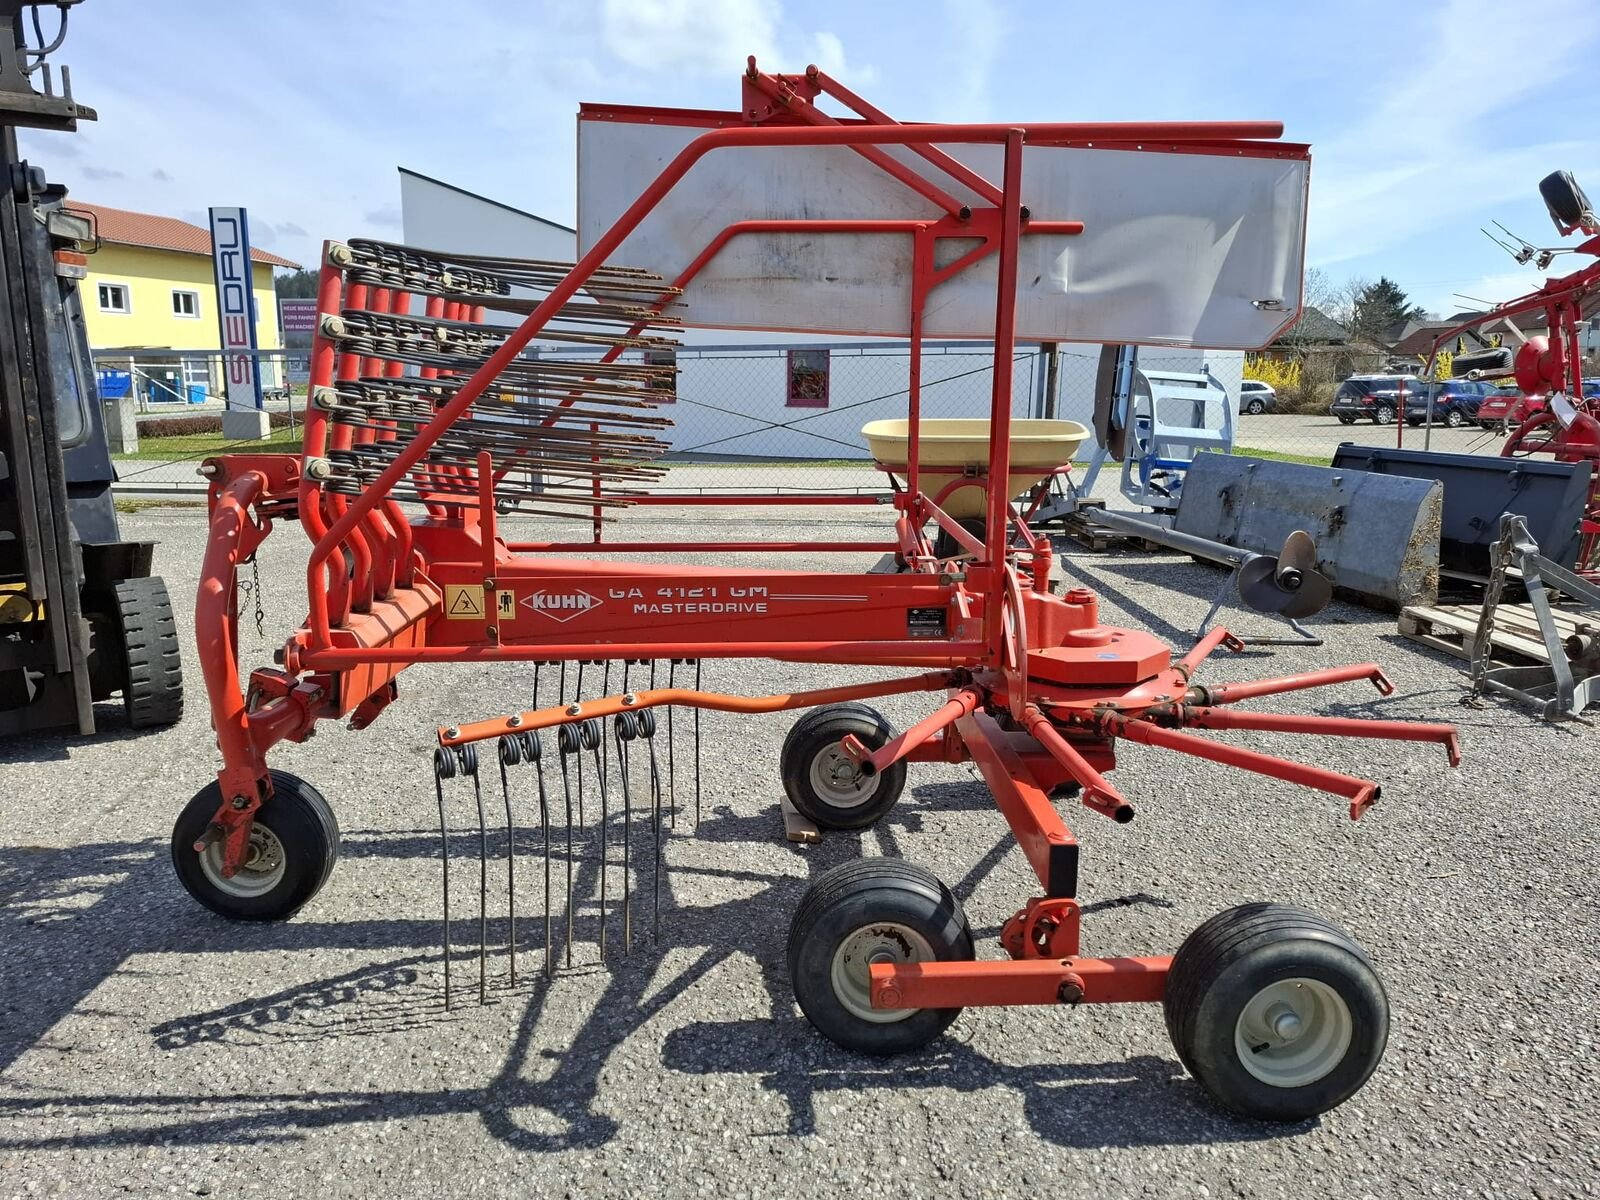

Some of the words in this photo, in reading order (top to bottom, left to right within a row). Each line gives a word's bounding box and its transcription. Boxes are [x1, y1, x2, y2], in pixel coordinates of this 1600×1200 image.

[217, 217, 251, 385] SEDRU
[608, 587, 643, 599] GA
[657, 587, 717, 598] 4121
[730, 586, 767, 598] GM
[532, 594, 592, 609] KUHN
[633, 602, 767, 614] MASTERDRIVE
